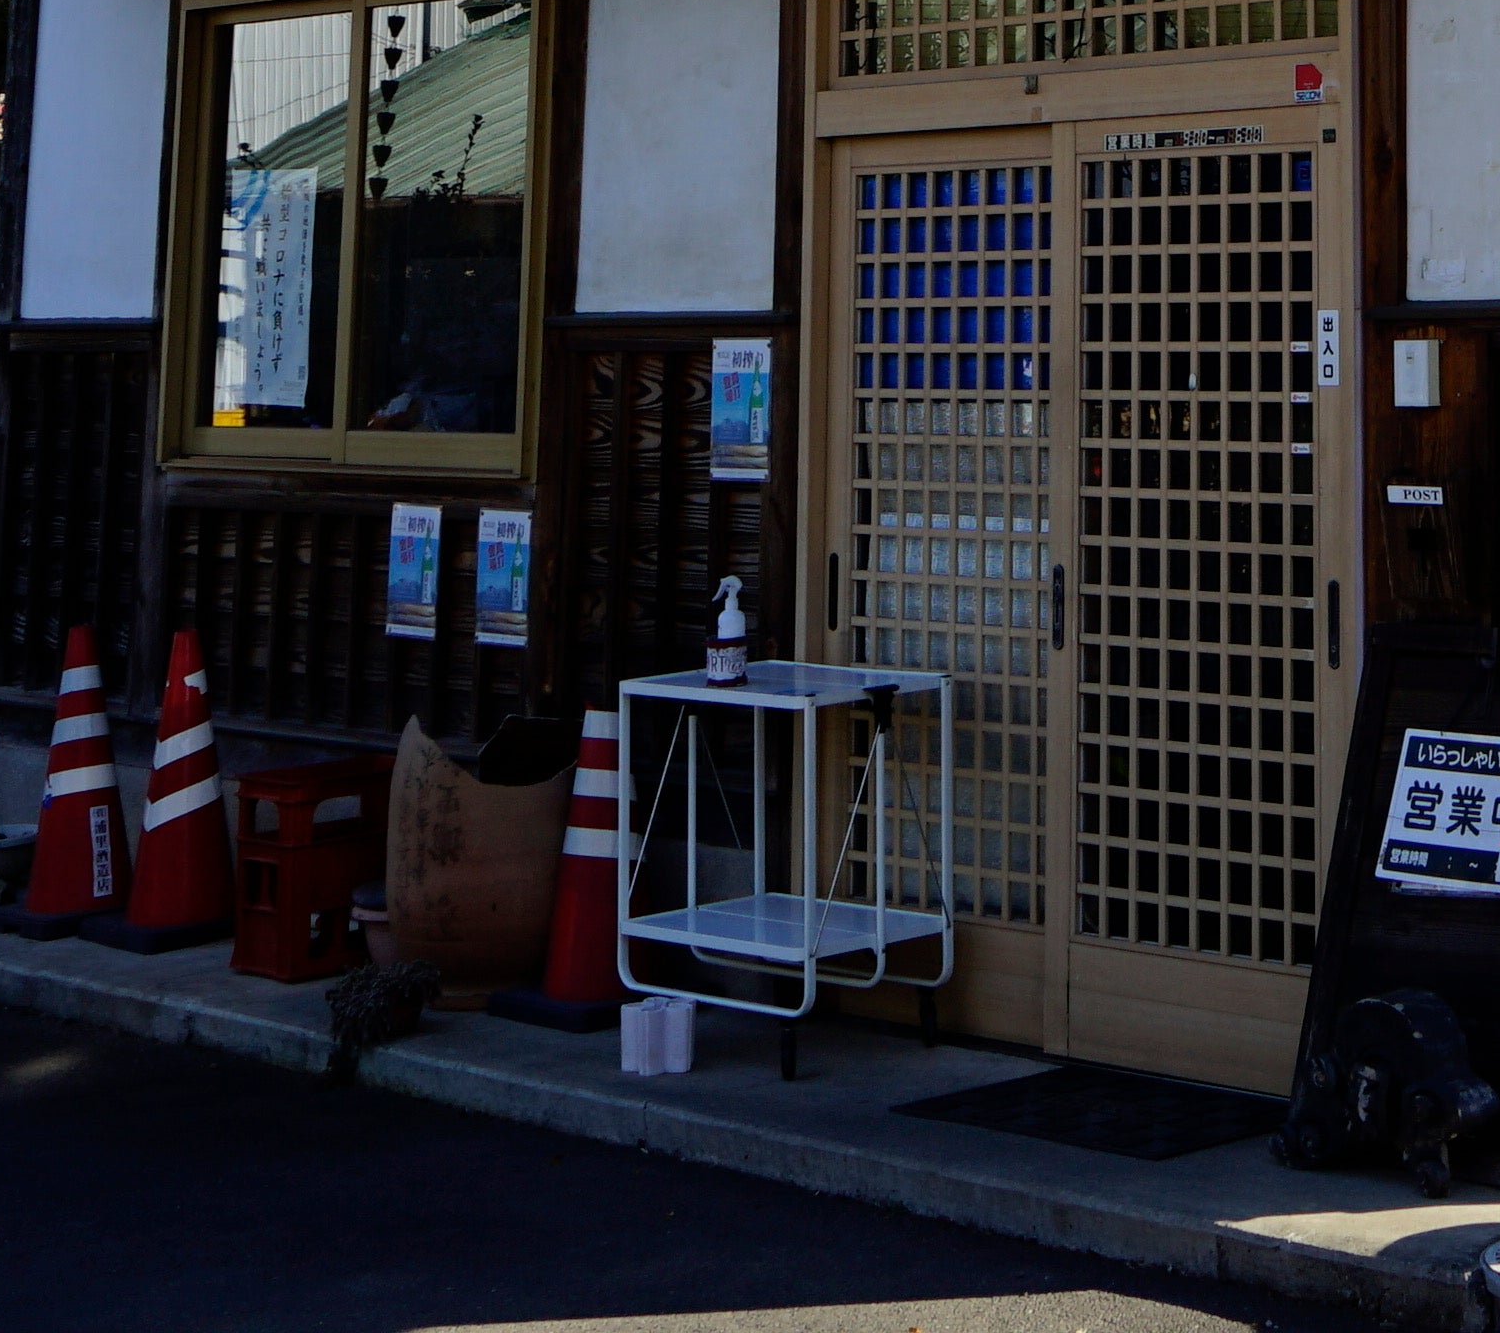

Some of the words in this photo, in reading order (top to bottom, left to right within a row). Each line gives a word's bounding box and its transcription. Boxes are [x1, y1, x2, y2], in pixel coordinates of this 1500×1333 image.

[1322, 316, 1335, 379] 出入口
[1402, 489, 1440, 502] POST
[1389, 847, 1430, 869] 営業時間
